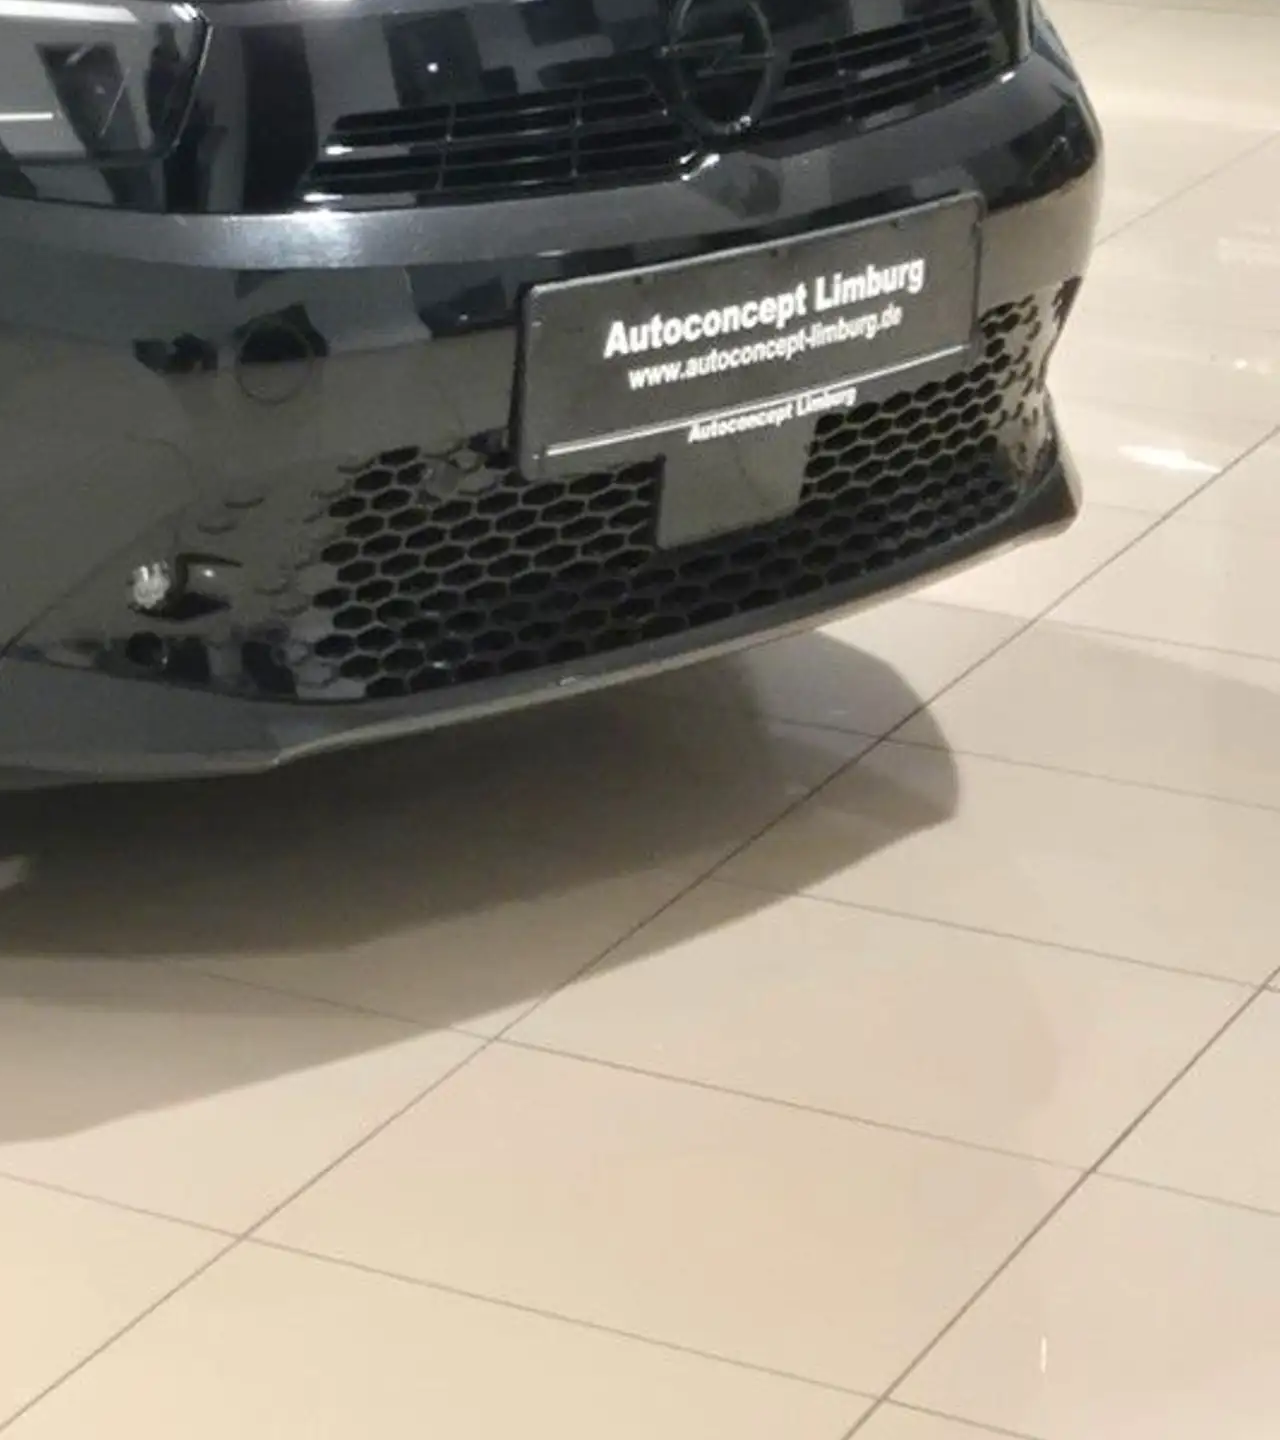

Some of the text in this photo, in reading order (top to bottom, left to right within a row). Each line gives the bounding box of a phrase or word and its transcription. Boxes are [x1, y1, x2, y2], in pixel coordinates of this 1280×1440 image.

[603, 258, 925, 359] Autoconcept Limburg
[627, 304, 903, 390] www.autoconcept-limburg.de
[686, 403, 793, 443] Autoconcept
